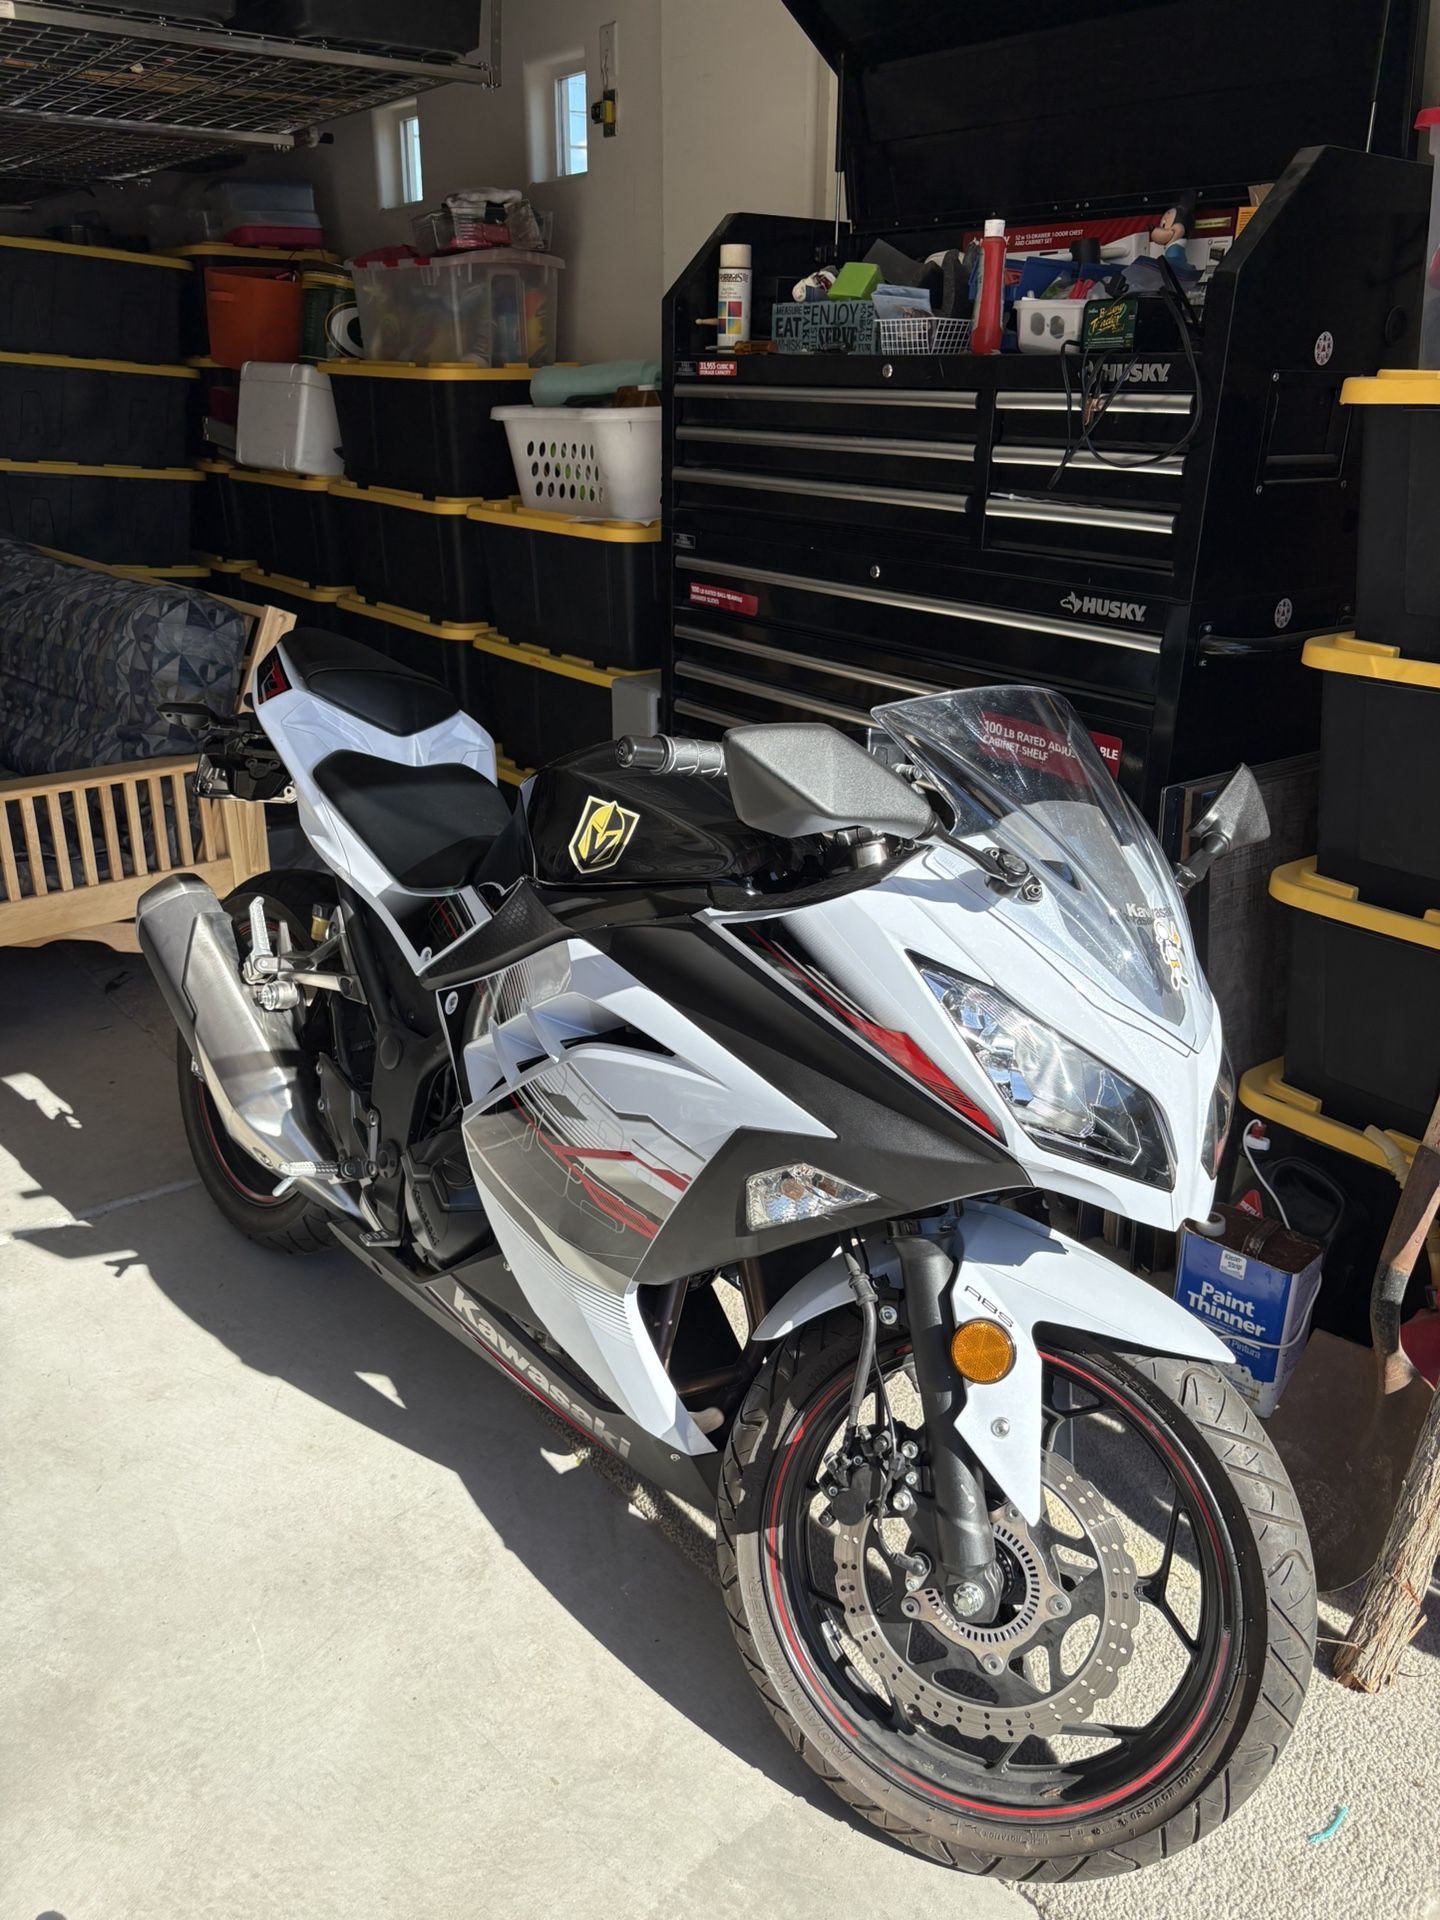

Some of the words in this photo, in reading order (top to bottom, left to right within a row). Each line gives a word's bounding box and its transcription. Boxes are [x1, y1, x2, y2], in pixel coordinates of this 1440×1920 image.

[1026, 238, 1044, 246] CABINET
[1069, 229, 1084, 237] CHEST
[776, 304, 802, 316] MEASURE
[811, 303, 859, 326] ENJOY
[776, 316, 802, 338] EAT
[802, 304, 811, 351] BAKE
[1102, 362, 1171, 382] HUSKY
[1082, 596, 1147, 622] HUSKY
[984, 719, 1002, 736] 100
[1003, 726, 1015, 740] LB
[1016, 731, 1047, 748] RATED
[982, 734, 1019, 754] CABINET
[1021, 745, 1049, 762] SHELF
[964, 1285, 1014, 1328] ABS
[1201, 1280, 1255, 1318] Paint
[1187, 1290, 1266, 1338] Thinner
[1231, 1339, 1261, 1360] Pintura
[452, 1286, 632, 1459] Kawasaki
